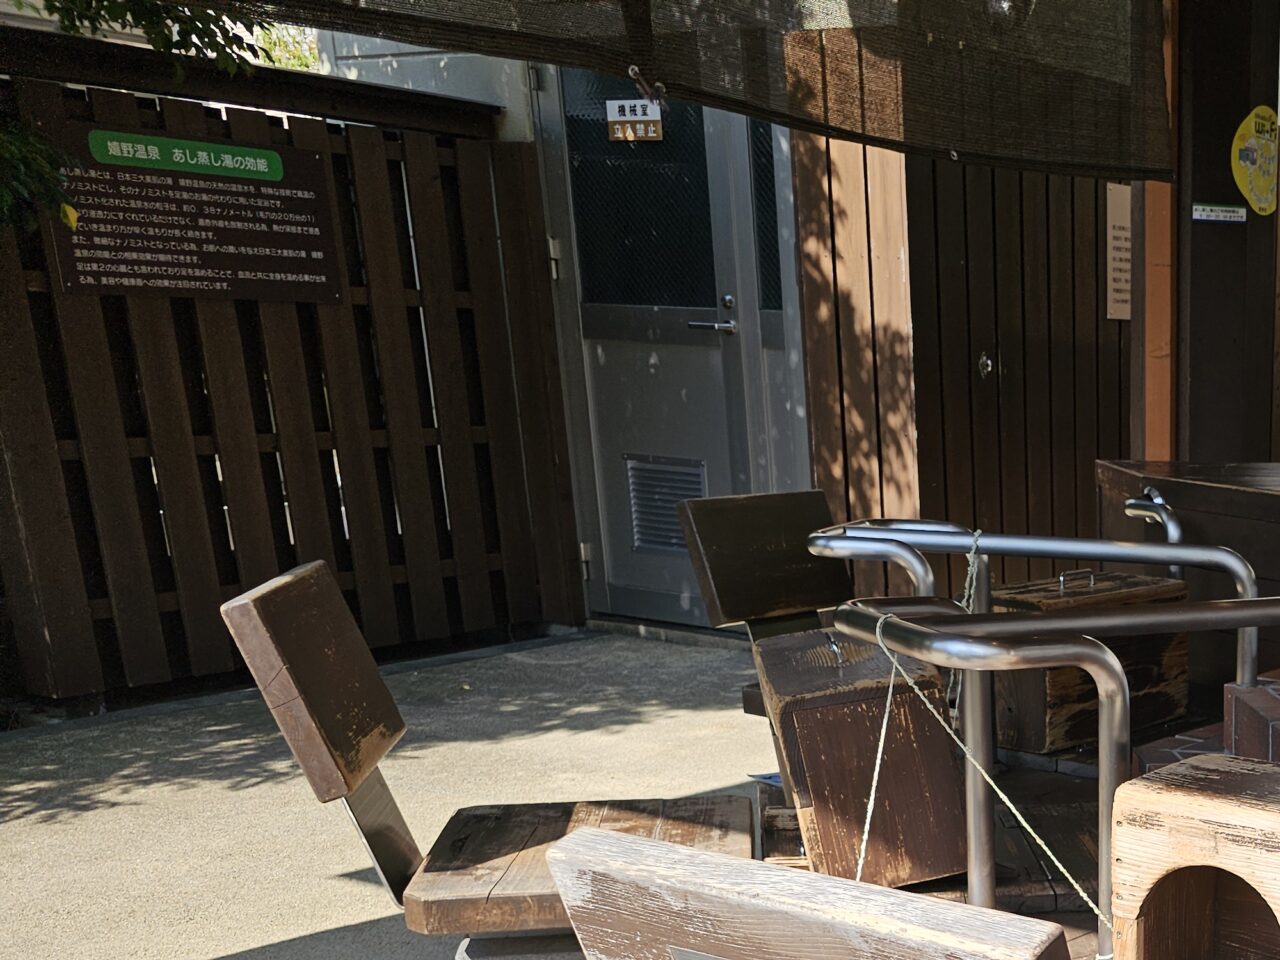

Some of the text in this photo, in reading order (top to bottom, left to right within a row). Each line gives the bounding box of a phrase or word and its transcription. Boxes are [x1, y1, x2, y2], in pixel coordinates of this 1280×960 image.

[618, 104, 648, 117] 機械室
[613, 123, 657, 138] 立入禁止
[107, 140, 269, 173] 嬉野温泉 あし蒸し湯の効能
